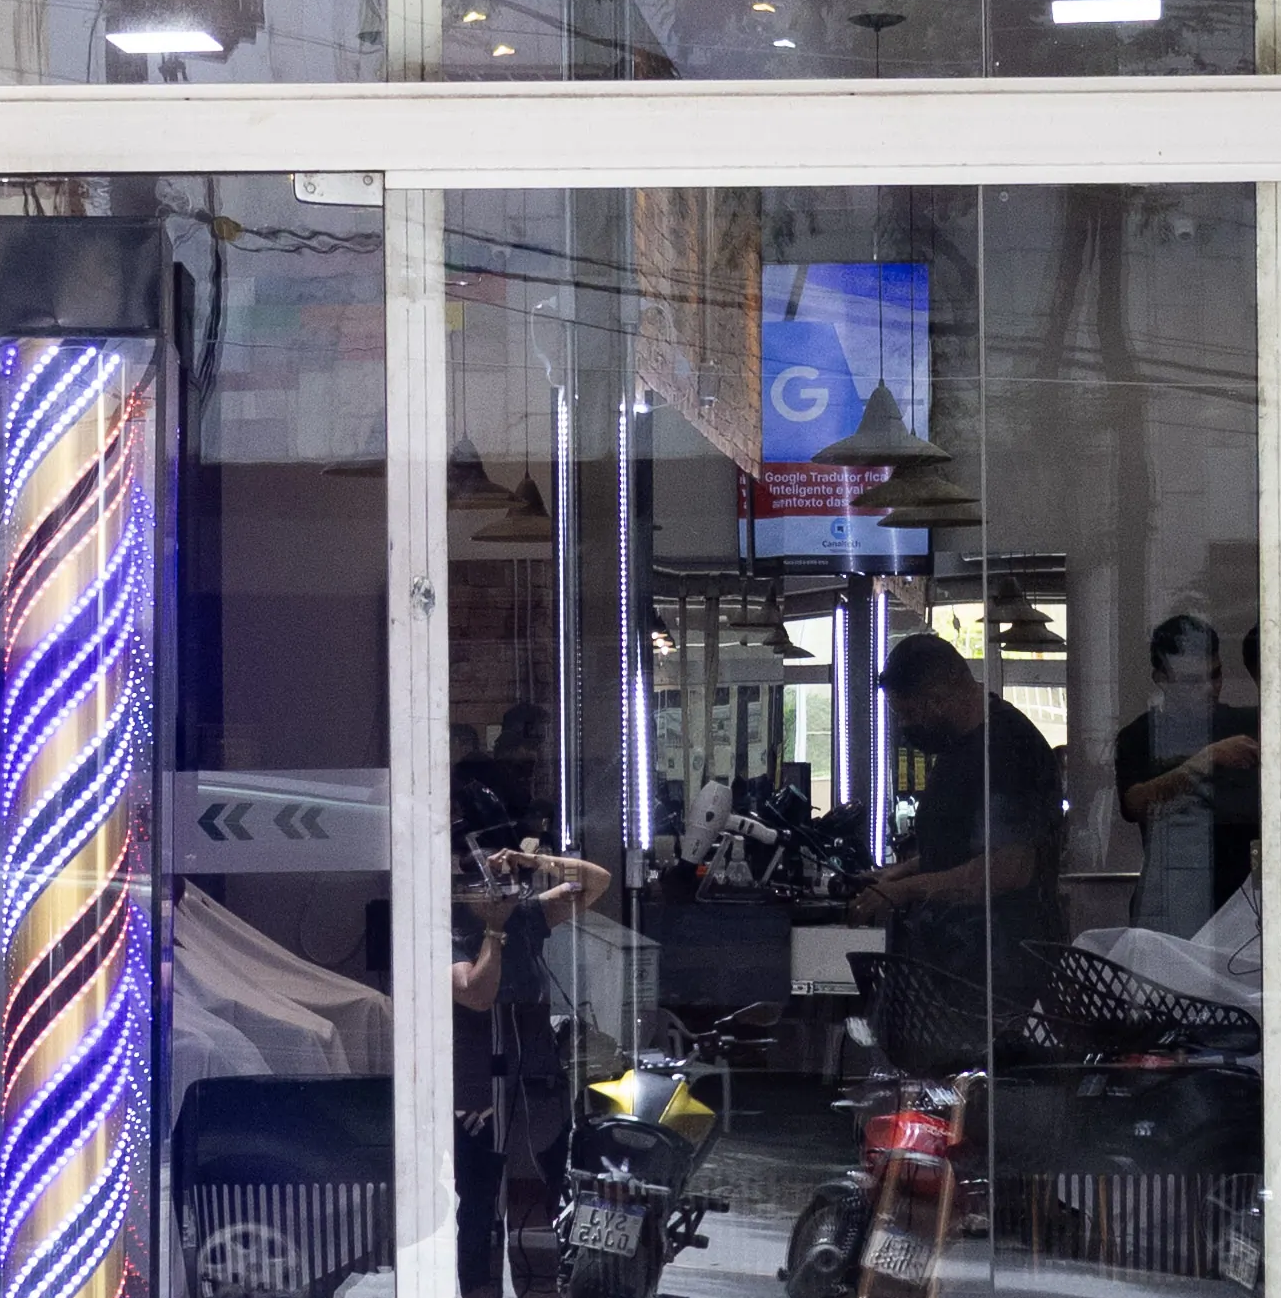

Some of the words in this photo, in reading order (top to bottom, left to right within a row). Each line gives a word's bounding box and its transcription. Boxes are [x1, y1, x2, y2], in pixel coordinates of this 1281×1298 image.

[770, 365, 829, 422] G
[765, 471, 807, 485] Google
[810, 471, 862, 482] Tradutor
